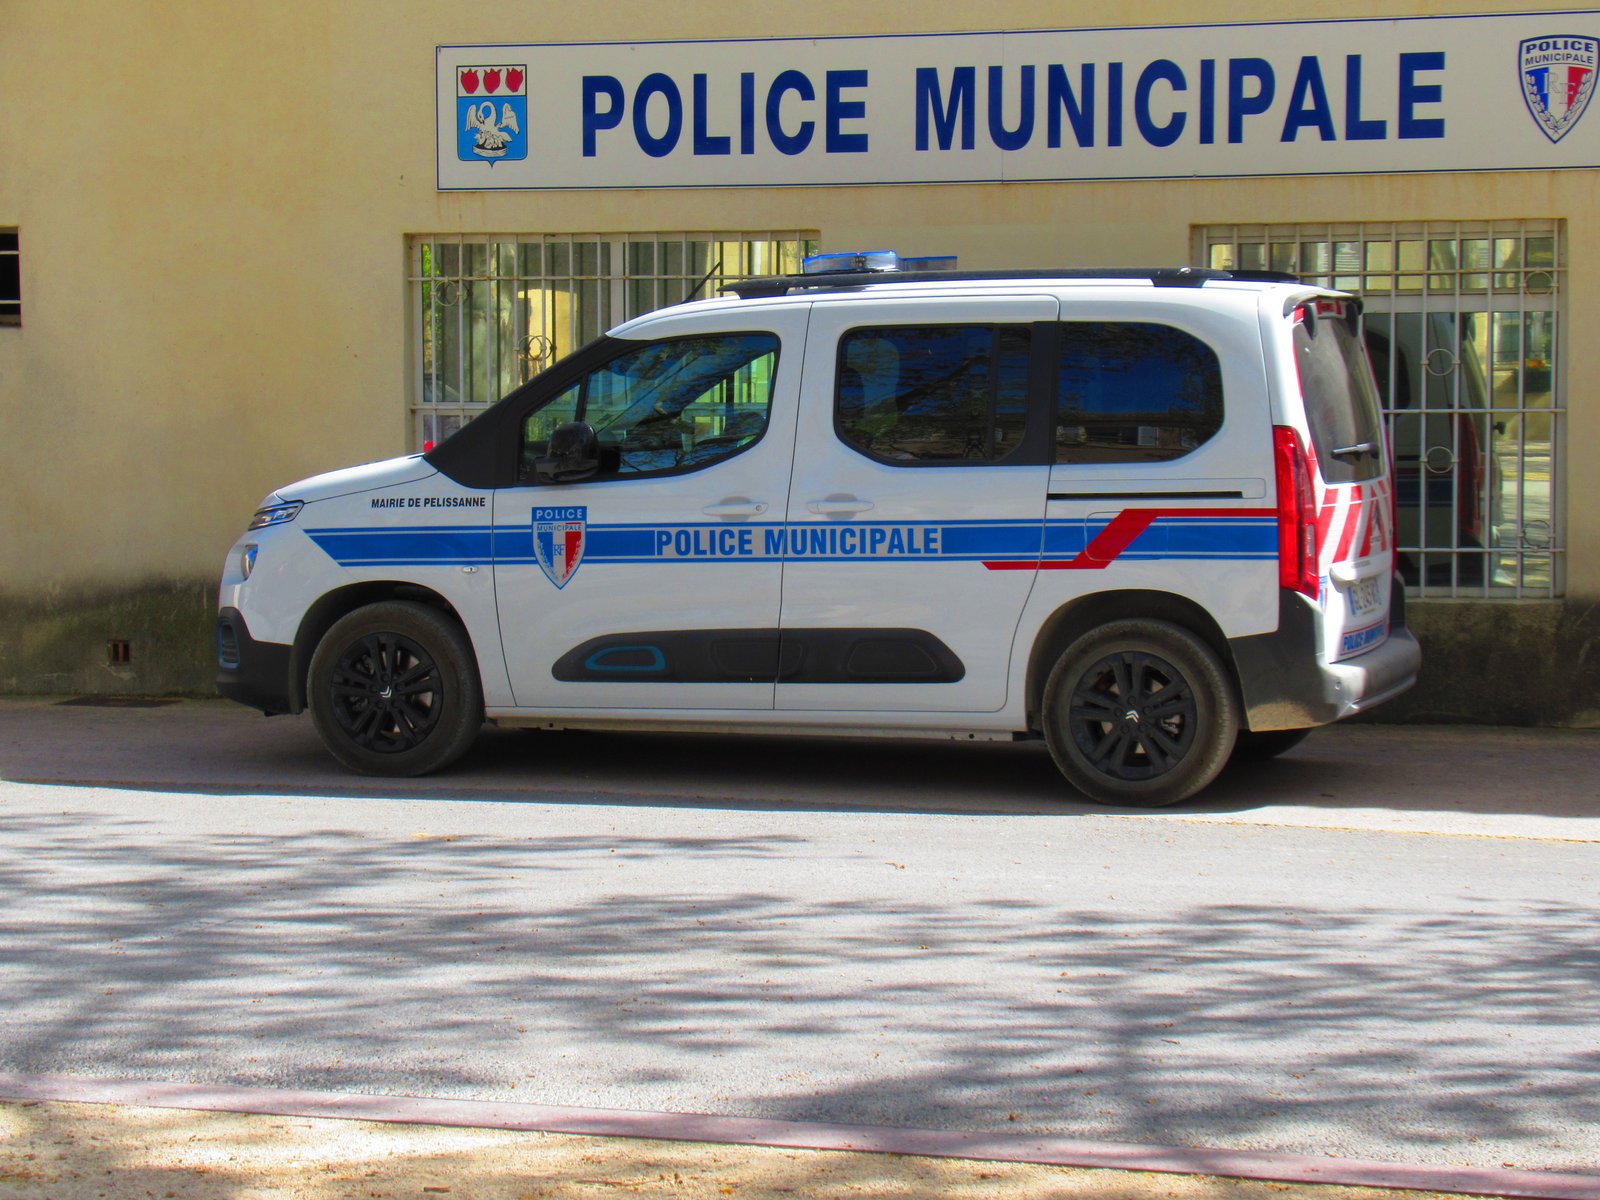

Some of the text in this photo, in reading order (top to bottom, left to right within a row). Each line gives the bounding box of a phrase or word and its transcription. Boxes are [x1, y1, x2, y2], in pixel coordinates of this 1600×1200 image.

[1525, 40, 1594, 54] POLICE
[1525, 53, 1594, 66] MUNICIPALE
[582, 51, 1446, 158] POLICE MUNICIPALE
[371, 497, 486, 508] MAIRIE DE PELISSANNE
[536, 508, 583, 519] POLICE
[537, 524, 582, 532] MUNICIPALE
[656, 527, 939, 556] POLICE MUNICIPALE
[553, 543, 565, 556] RF
